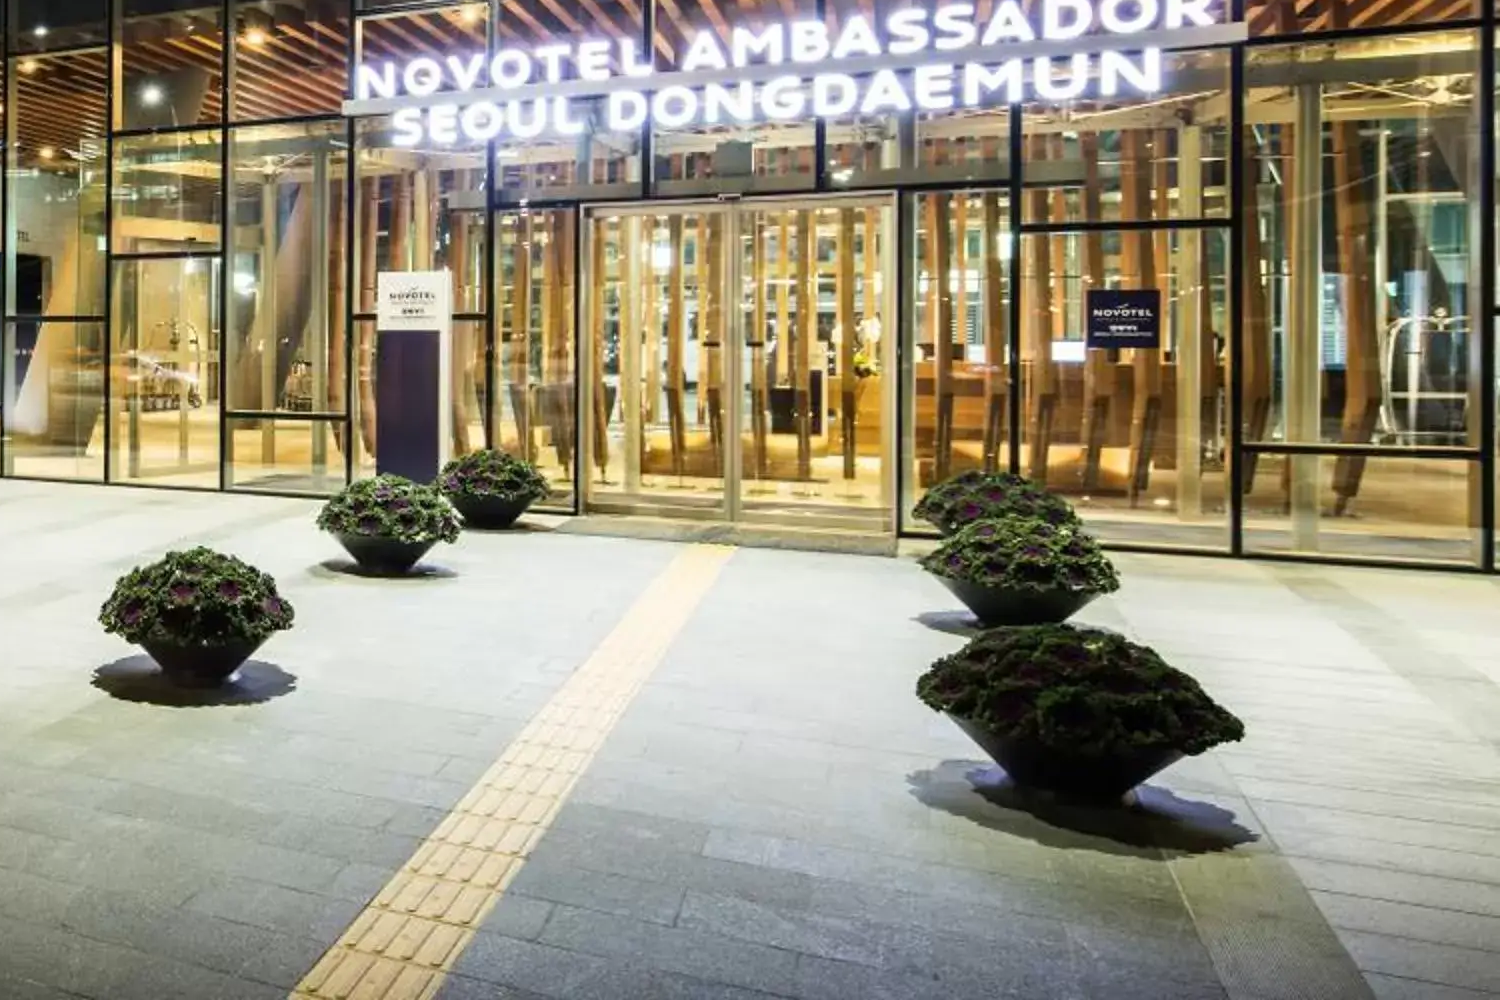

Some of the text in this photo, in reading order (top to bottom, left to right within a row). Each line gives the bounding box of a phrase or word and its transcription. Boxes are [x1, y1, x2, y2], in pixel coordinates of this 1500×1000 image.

[356, 38, 653, 100] NOVOTEL
[391, 47, 1161, 147] SEOUL DONGDAEMUN
[1092, 308, 1153, 318] NOVOTEL
